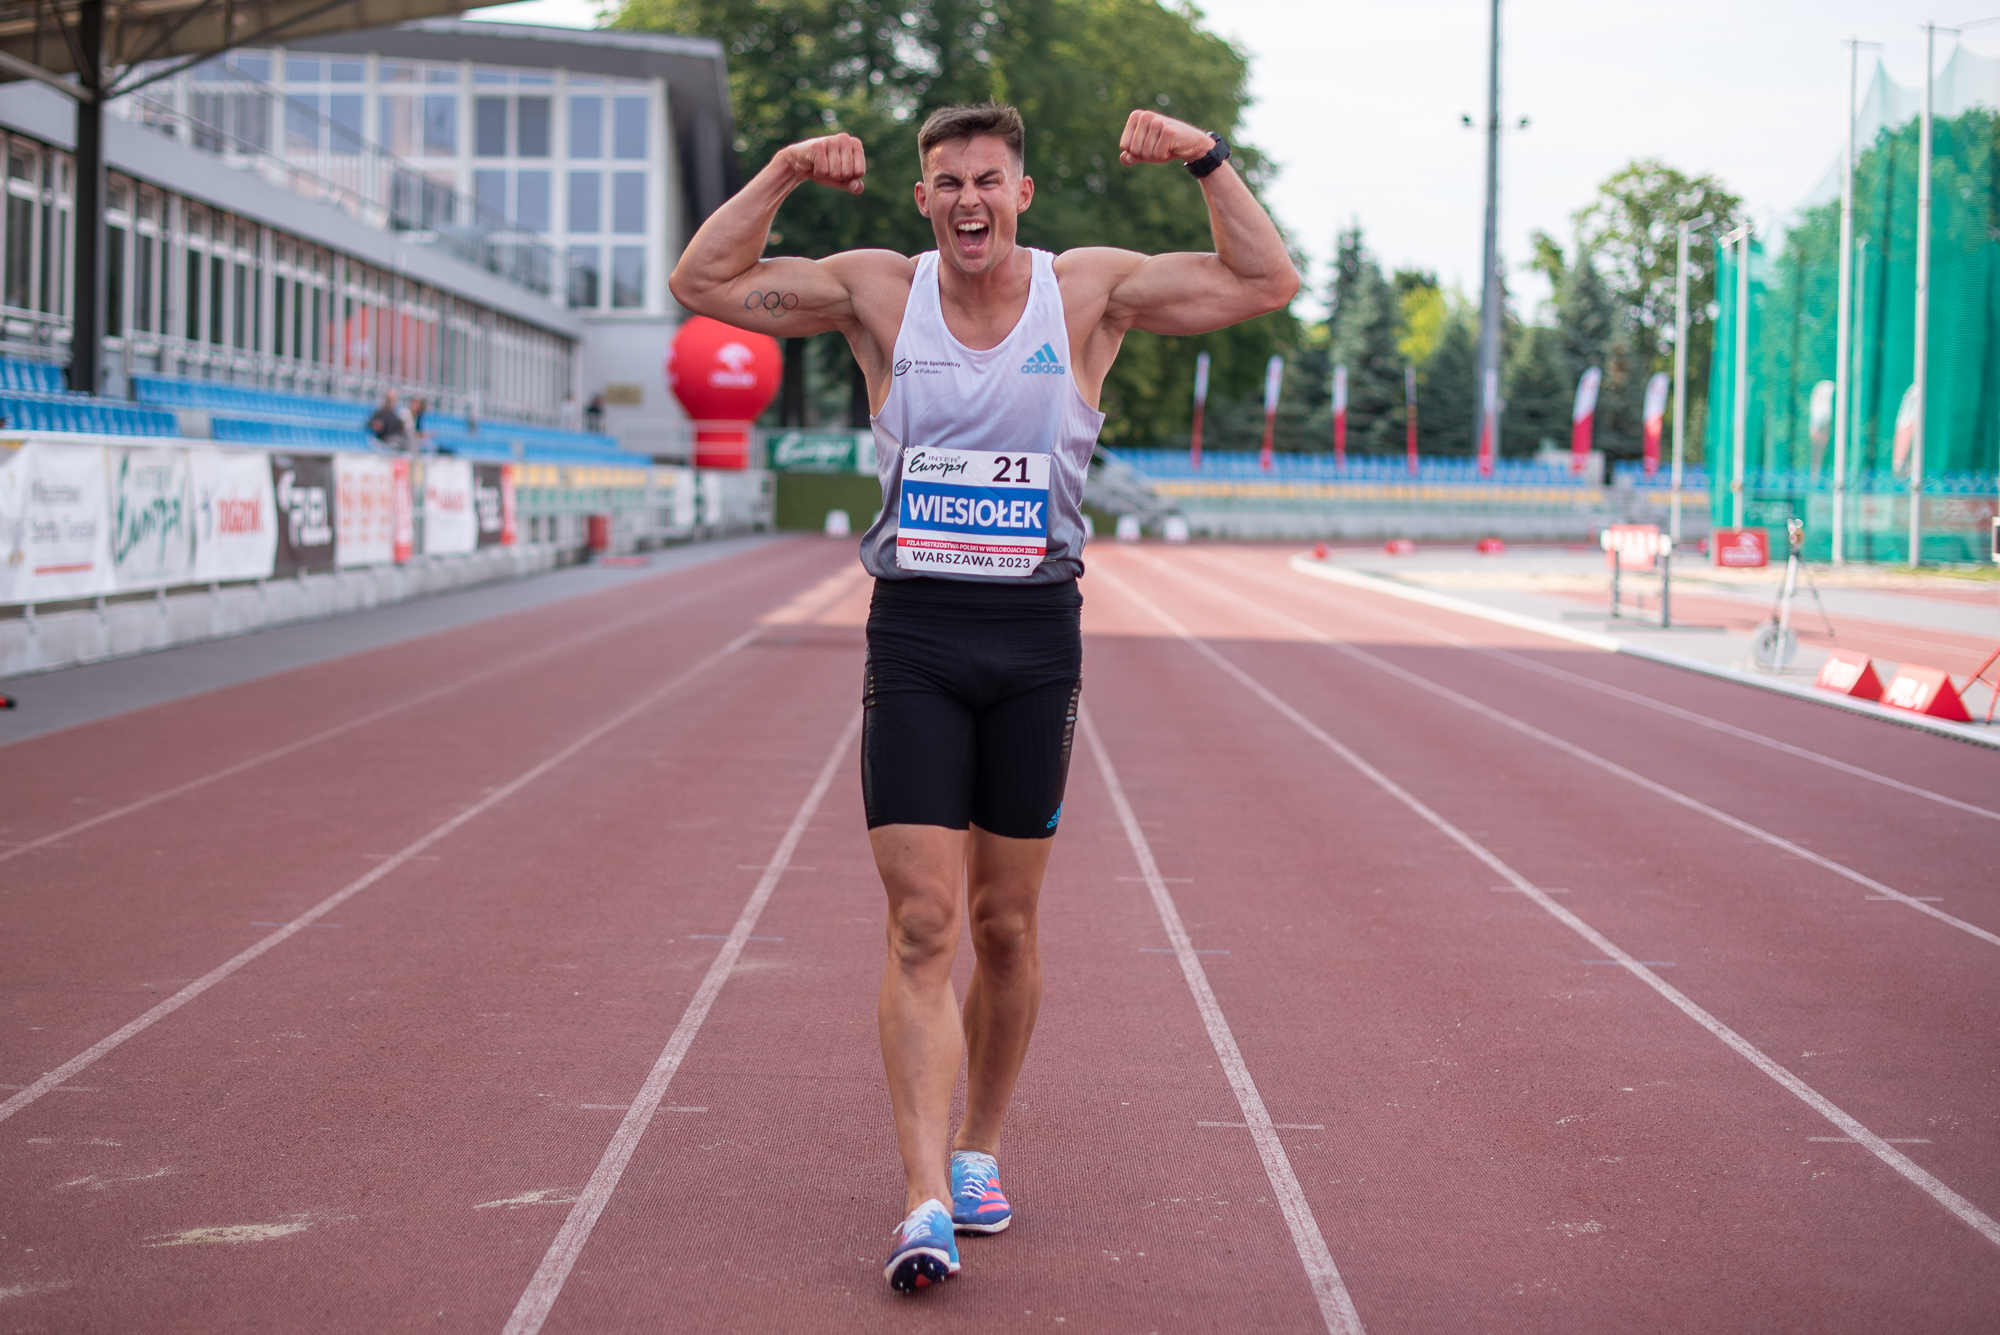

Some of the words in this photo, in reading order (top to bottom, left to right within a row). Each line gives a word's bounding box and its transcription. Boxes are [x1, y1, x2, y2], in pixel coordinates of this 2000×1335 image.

[1021, 362, 1065, 375] adidas
[908, 452, 968, 478] Europol
[992, 456, 1031, 483] 21
[907, 492, 1043, 529] WIESIOŁEK
[921, 541, 960, 549] MISTRZOSTWA
[985, 546, 1024, 554] WIELOBOJACH
[912, 550, 994, 567] WARSZAWA
[998, 556, 1030, 569] 2023
